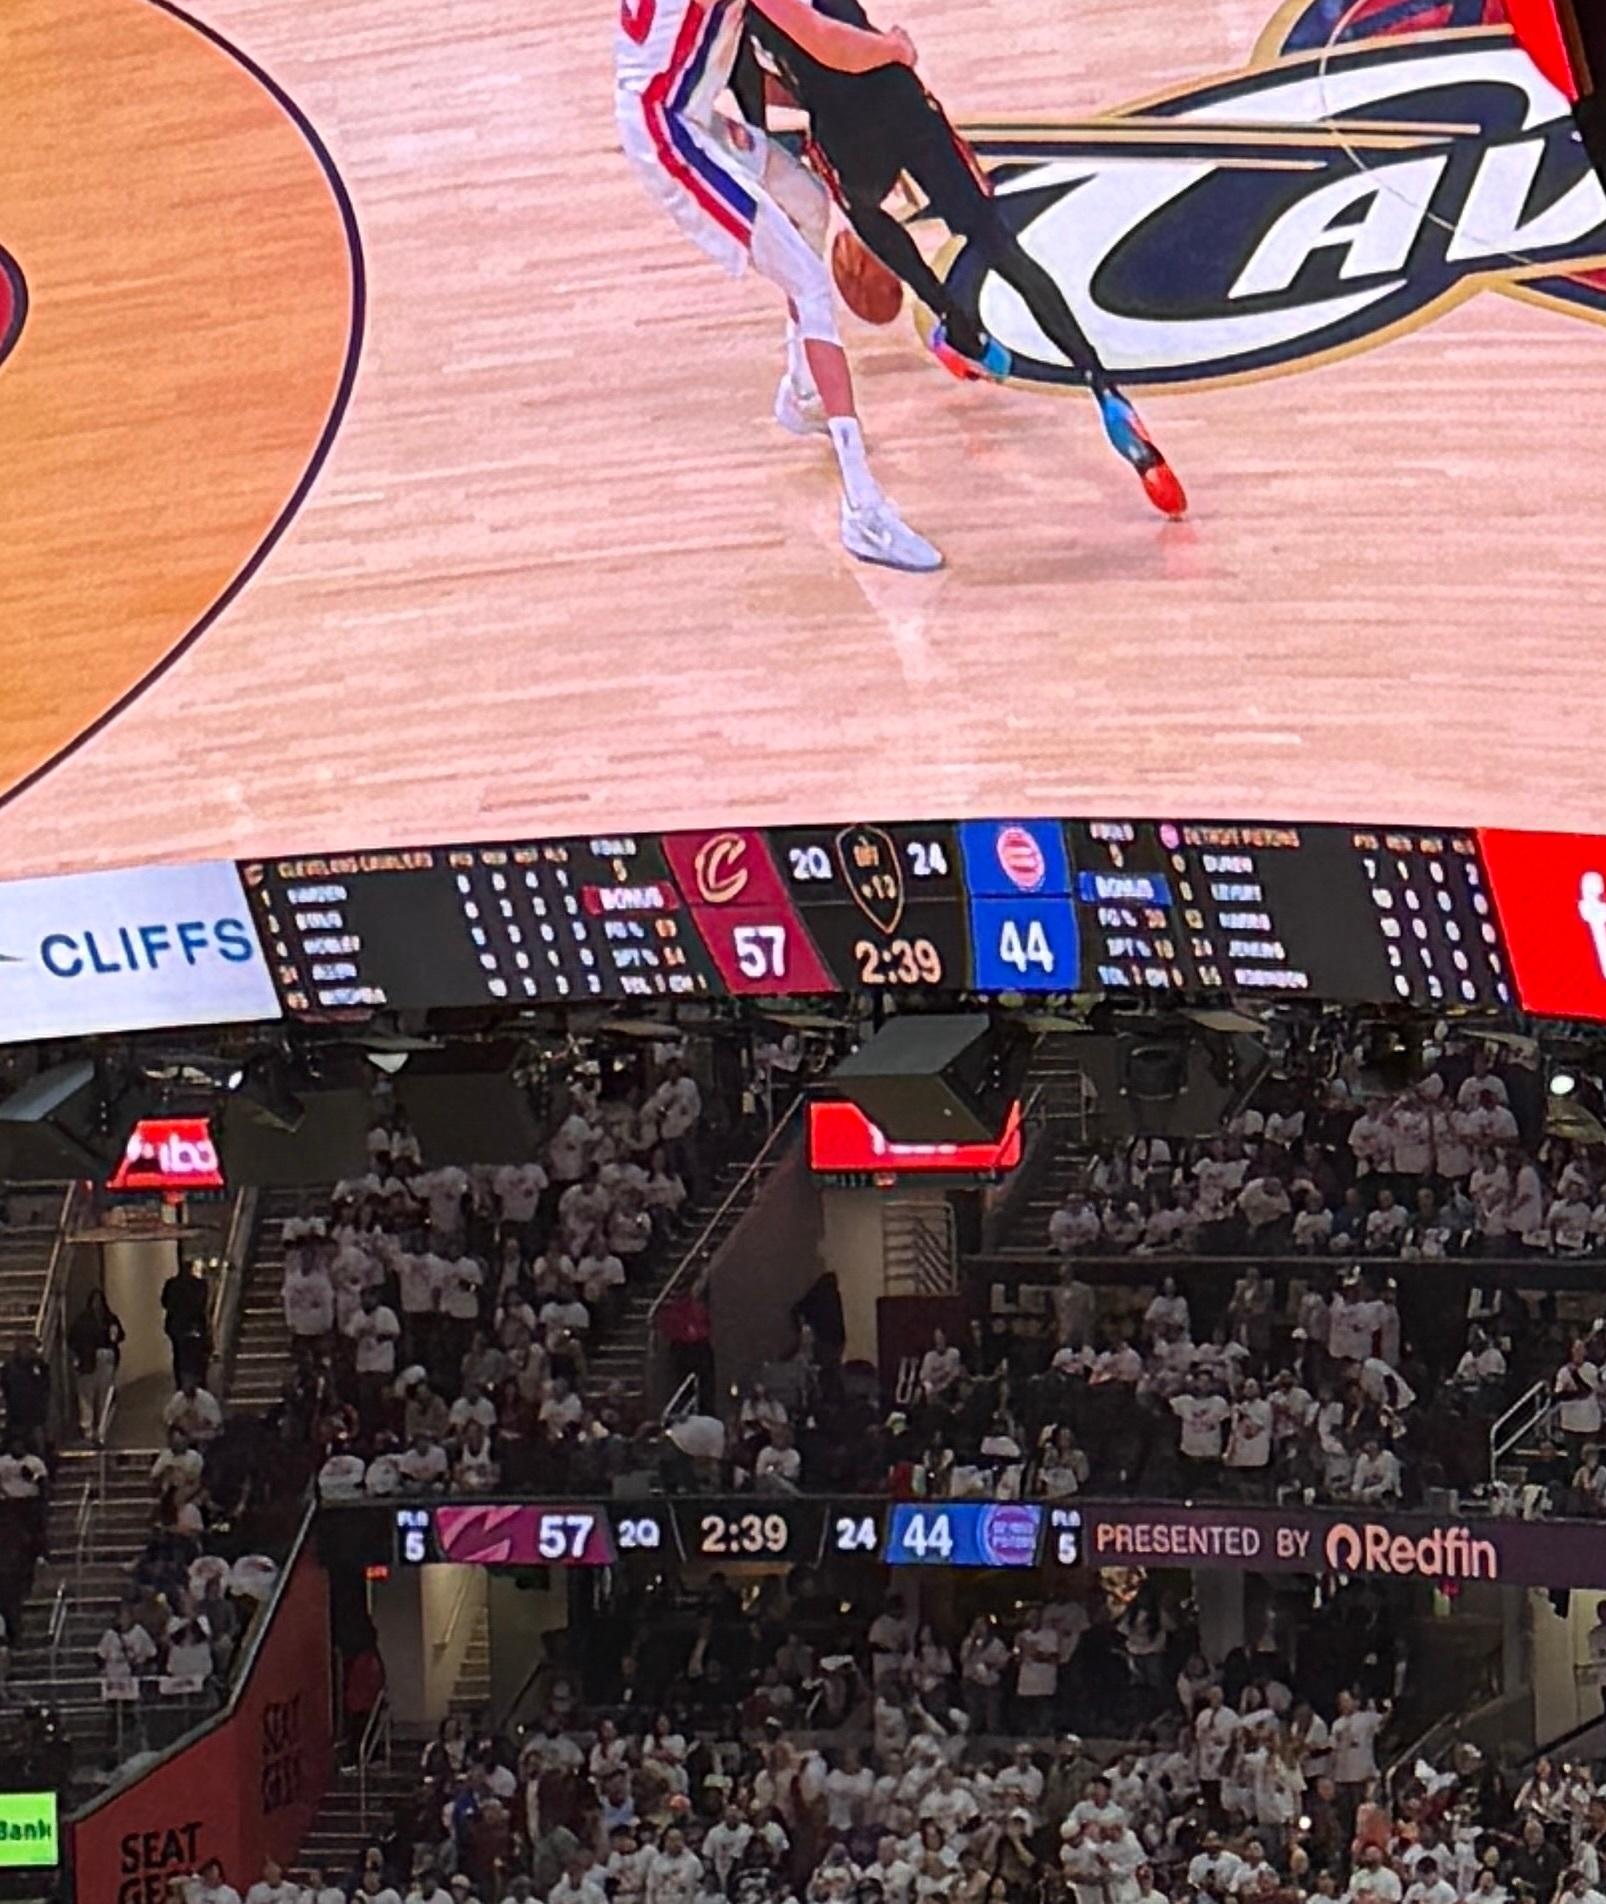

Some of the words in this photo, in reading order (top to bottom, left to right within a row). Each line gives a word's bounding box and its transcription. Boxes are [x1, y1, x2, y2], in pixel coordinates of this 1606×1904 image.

[790, 849, 832, 880] 2Q
[907, 843, 948, 876] 24
[41, 918, 254, 977] CLIFFS
[734, 926, 785, 978] 57
[855, 939, 941, 985] 2:39
[1000, 921, 1054, 973] 44
[538, 1513, 596, 1558] 57
[618, 1520, 660, 1549] 2Q
[700, 1514, 788, 1553] 2:39
[836, 1520, 877, 1549] 24
[902, 1513, 953, 1557] 44
[1097, 1524, 1260, 1557] PRESENTED
[1277, 1528, 1311, 1559] BY
[1365, 1524, 1497, 1579] Redfin
[121, 1822, 203, 1873] SEAT
